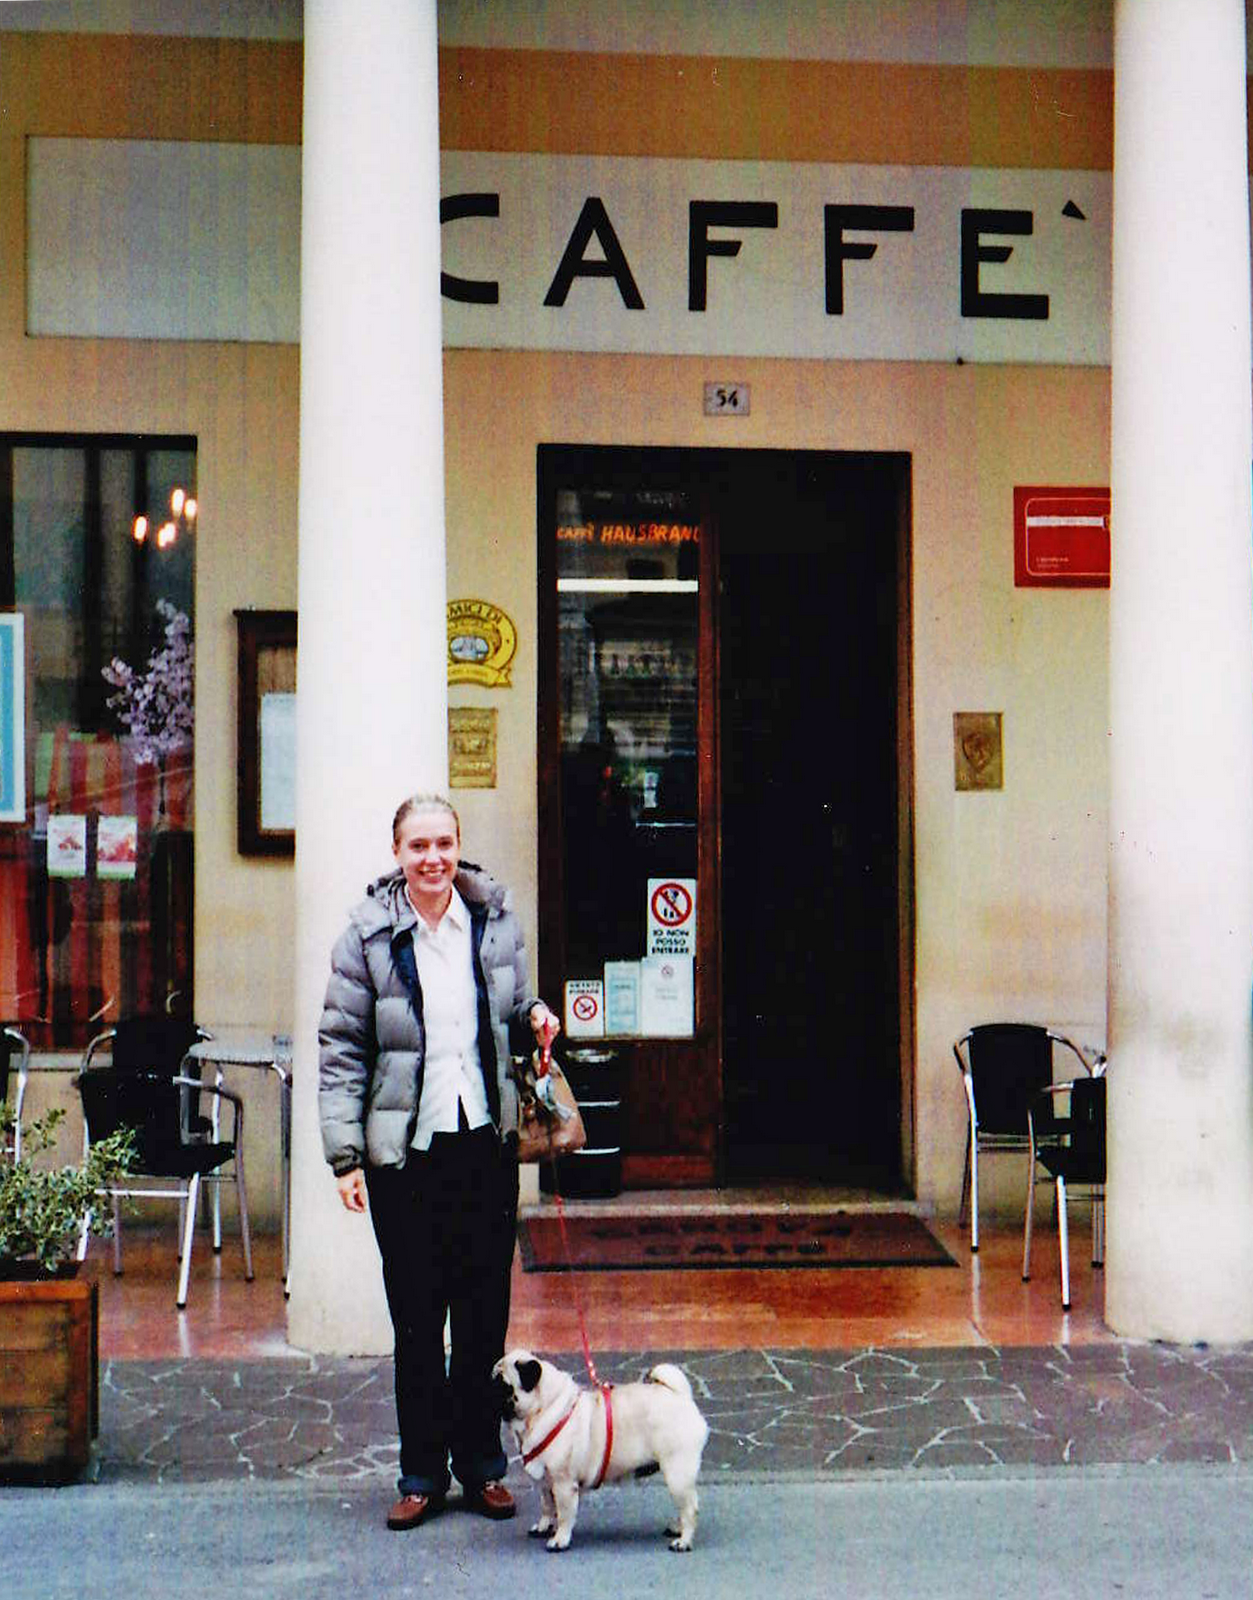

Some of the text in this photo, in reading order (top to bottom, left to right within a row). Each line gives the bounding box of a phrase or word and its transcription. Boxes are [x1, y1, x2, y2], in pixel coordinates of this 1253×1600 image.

[717, 389, 738, 407] 54
[447, 603, 482, 619] MICI
[667, 929, 689, 937] NON
[656, 937, 686, 946] POSSO
